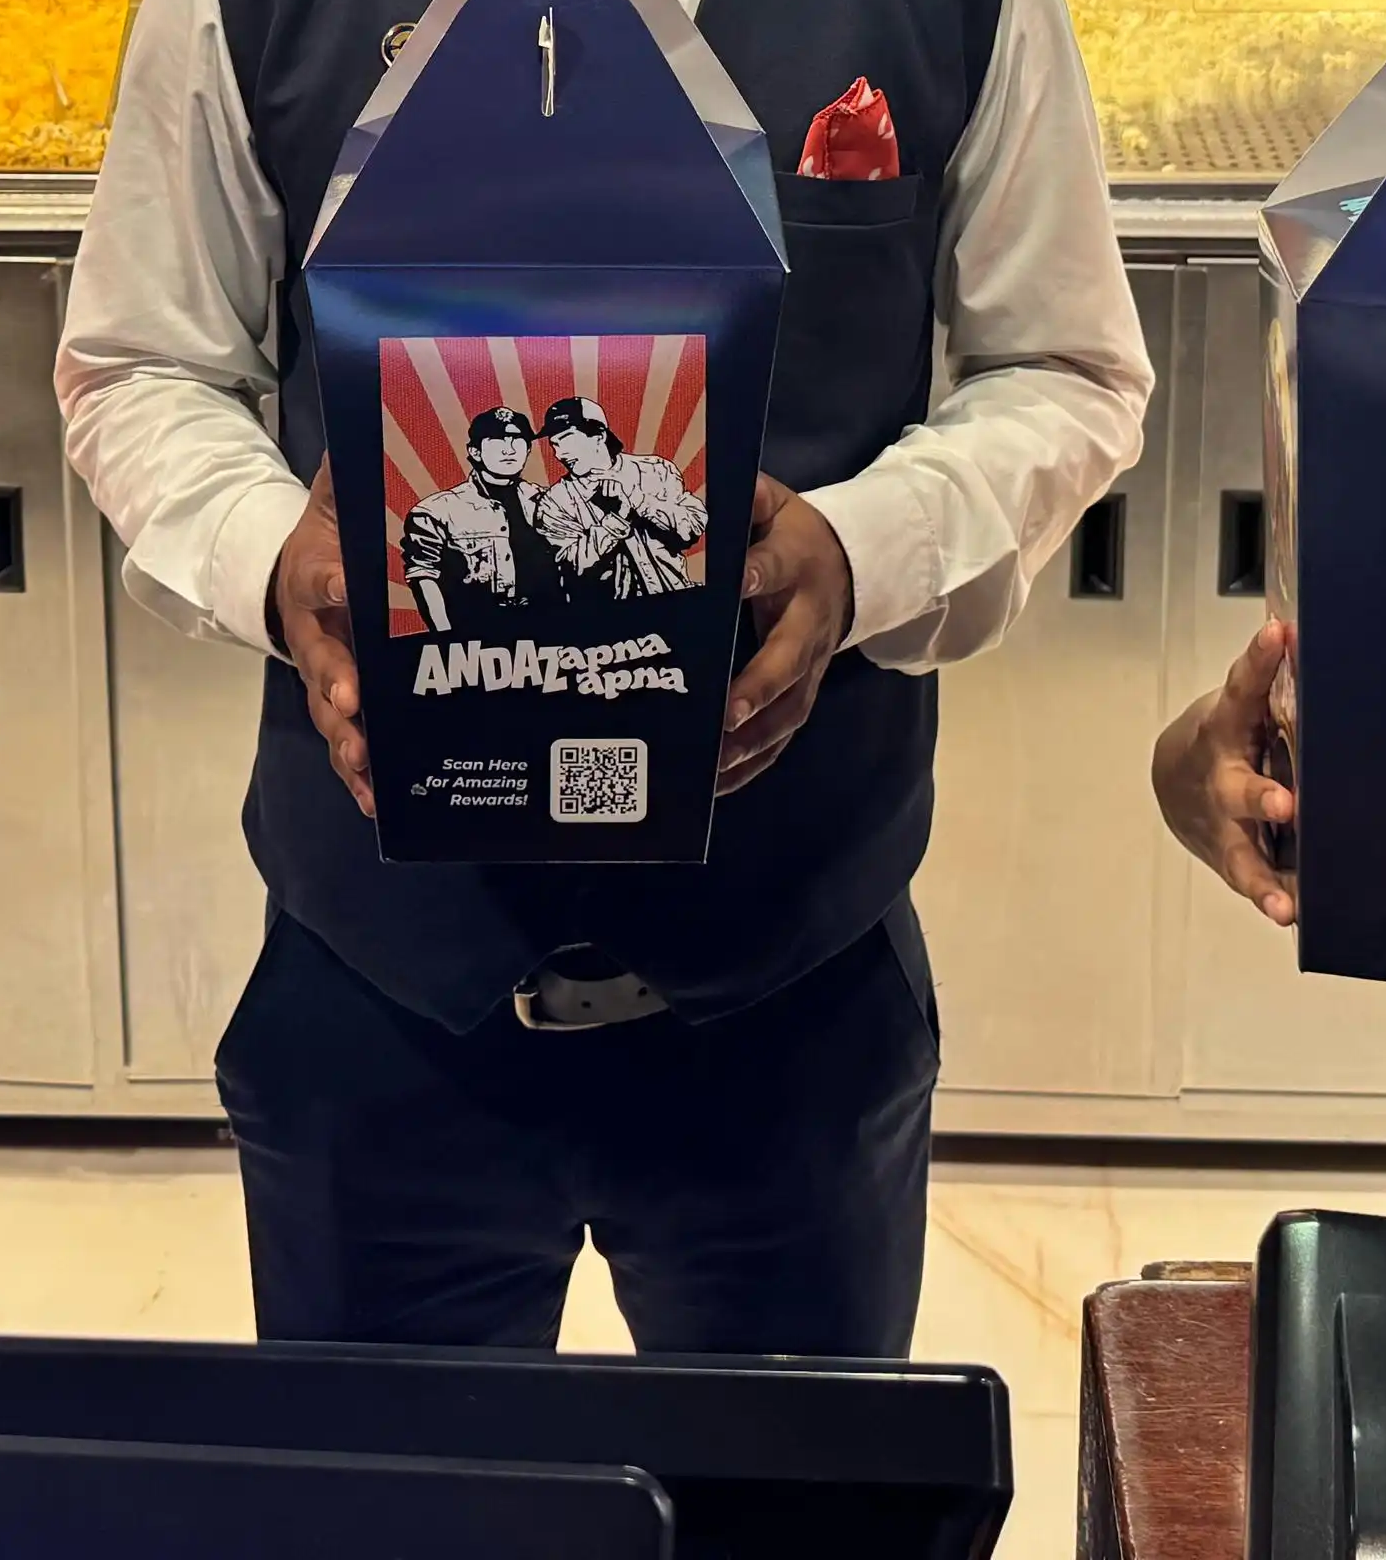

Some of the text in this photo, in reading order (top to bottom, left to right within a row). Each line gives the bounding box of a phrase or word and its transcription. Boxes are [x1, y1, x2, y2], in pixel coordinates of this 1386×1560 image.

[412, 633, 671, 696] ANDAZ apna
[576, 666, 689, 700] apna
[442, 758, 528, 772] Scan Here
[425, 775, 528, 791] for Amazing
[449, 793, 529, 807] Rewards!
